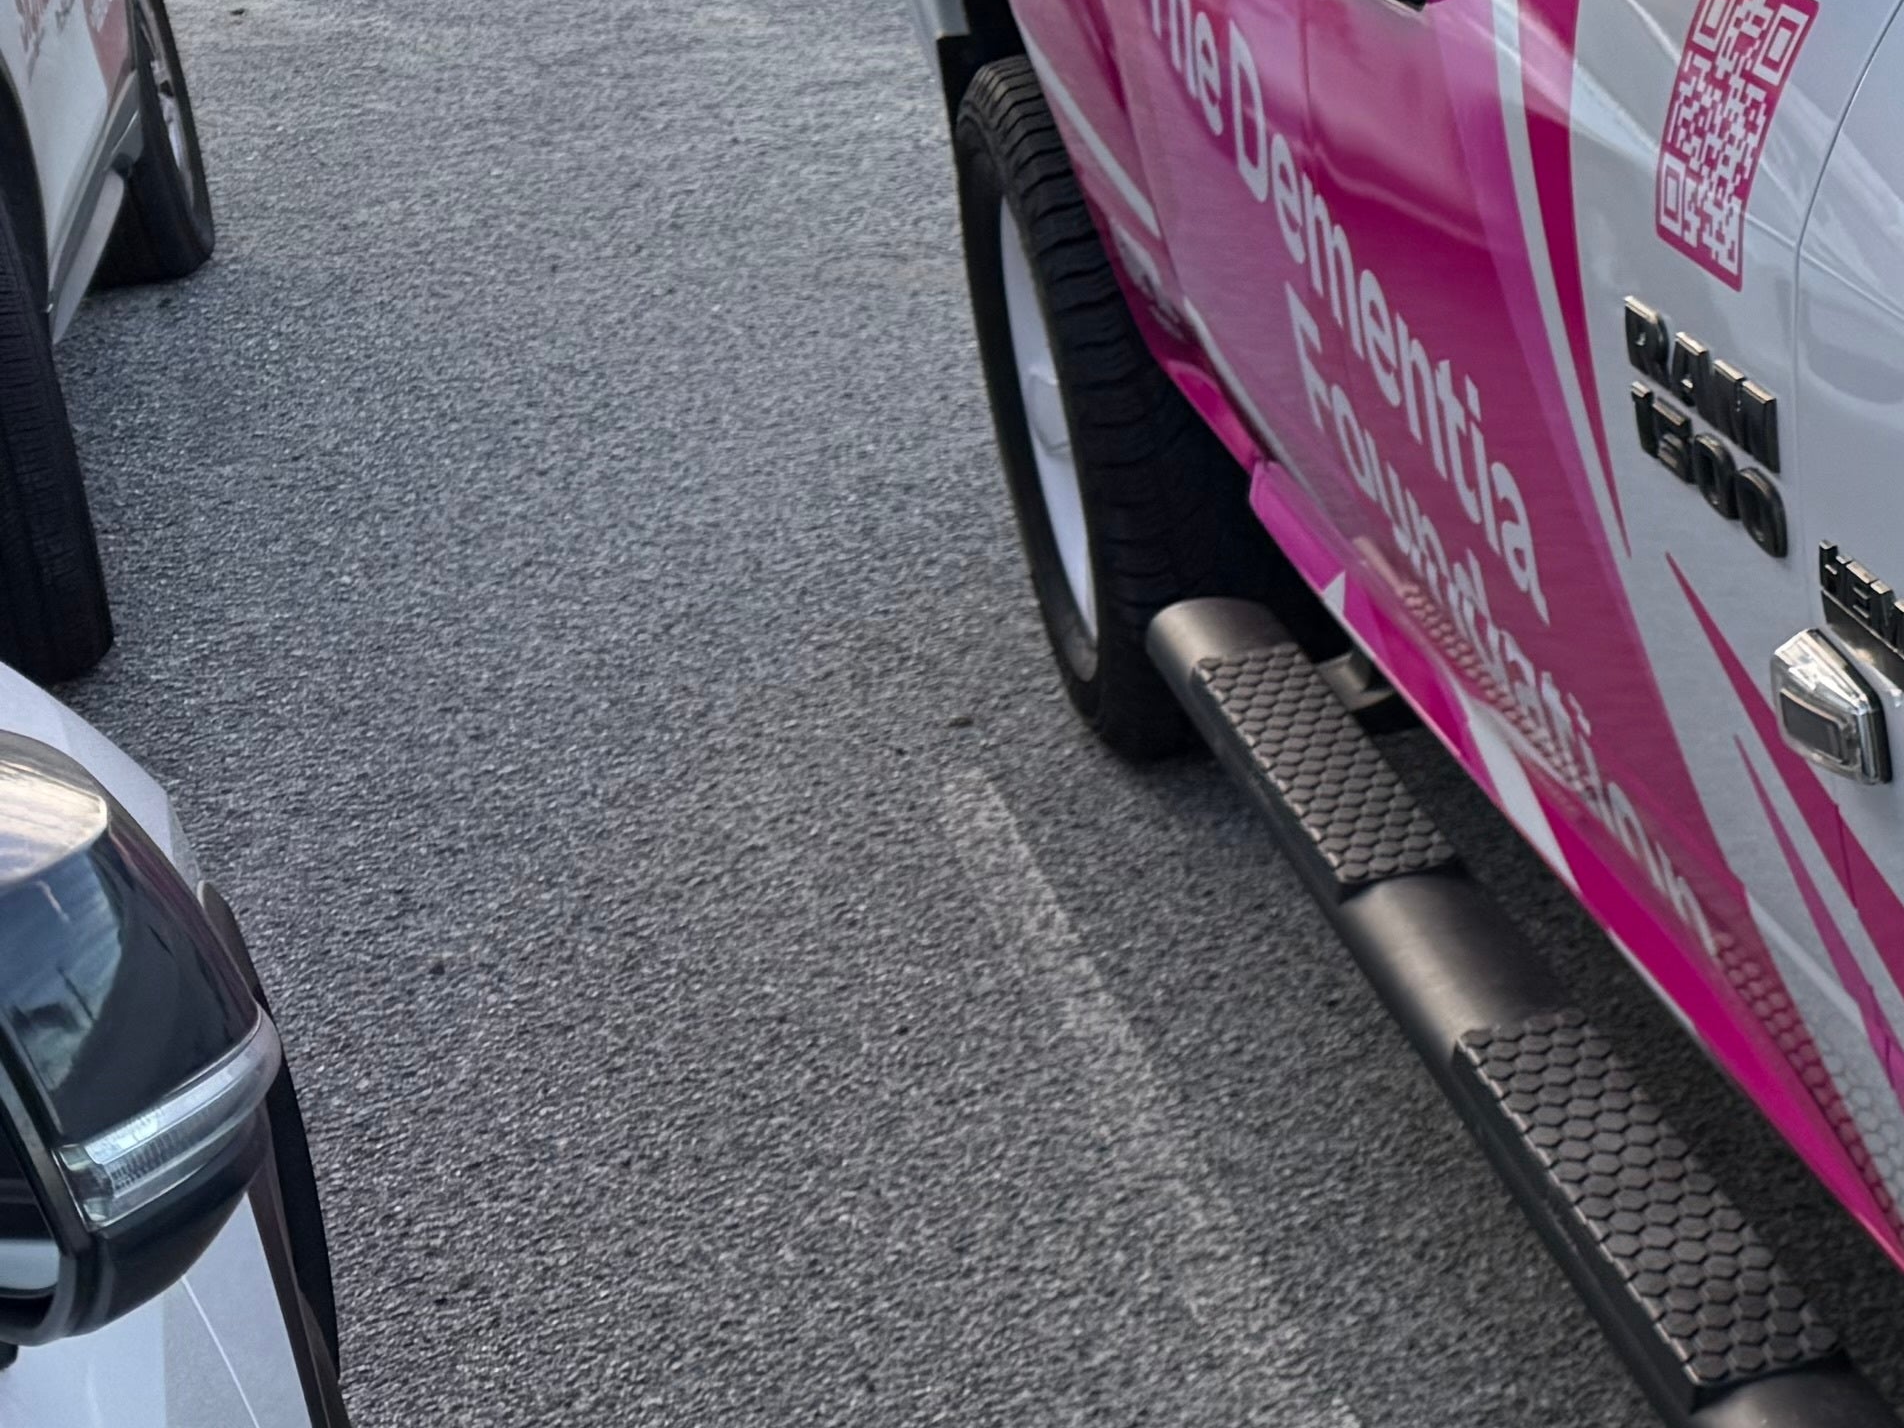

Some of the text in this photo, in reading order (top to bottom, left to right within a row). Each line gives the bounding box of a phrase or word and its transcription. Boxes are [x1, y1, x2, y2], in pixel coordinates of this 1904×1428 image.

[1228, 18, 1552, 627] Dementia
[1623, 295, 1781, 474] RAM
[1630, 380, 1789, 558] 1500
